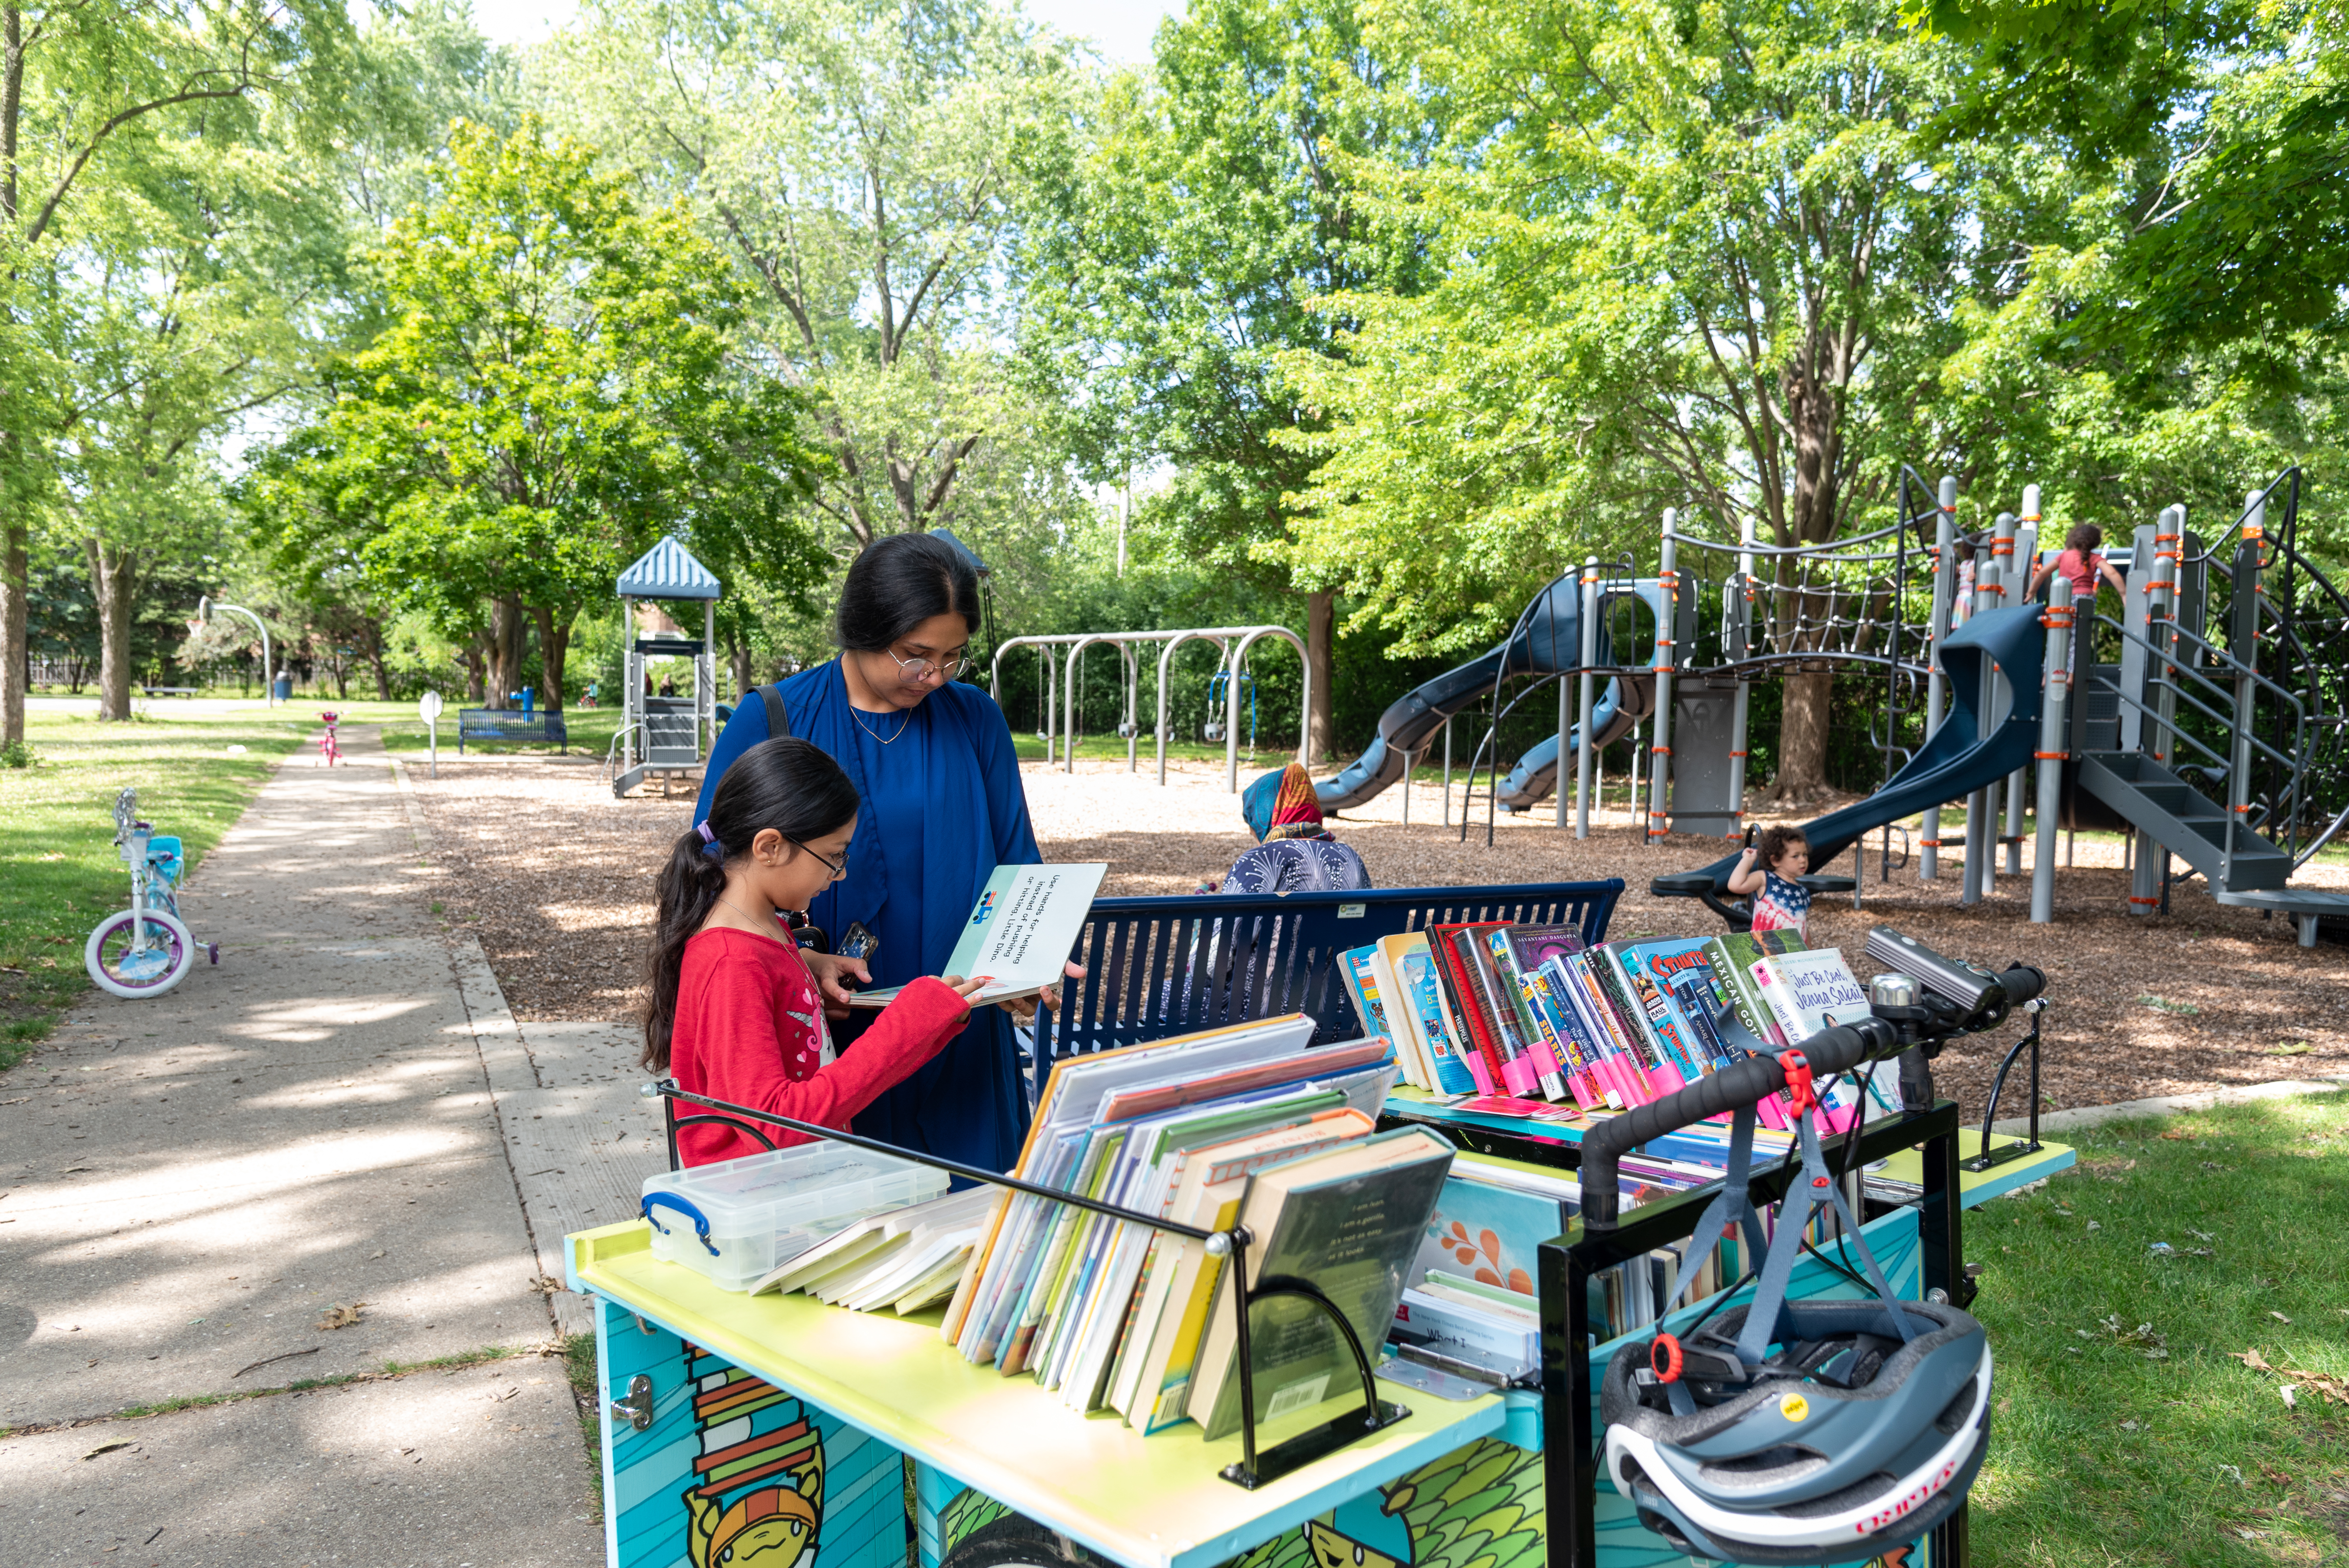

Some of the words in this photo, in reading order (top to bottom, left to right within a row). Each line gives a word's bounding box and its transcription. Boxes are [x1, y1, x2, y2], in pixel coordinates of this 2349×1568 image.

[1049, 875, 1060, 889] Use
[1010, 888, 1030, 916] hitting,
[1026, 881, 1045, 910] instead
[1036, 892, 1052, 915] hands
[1021, 913, 1028, 922] of
[1030, 919, 1039, 931] for
[1001, 919, 1015, 940] Little
[1004, 925, 1023, 957] pushing
[990, 943, 1004, 962] Dino.
[1013, 934, 1032, 964] helping
[1585, 952, 1595, 969] BEIL
[1430, 944, 1440, 963] MARJANE
[1437, 963, 1447, 980] SATRAPI
[1670, 972, 1690, 985] LUESTEM
[1793, 972, 1812, 988] Just
[1810, 971, 1825, 985] Be
[1824, 968, 1848, 984] Cool,
[1551, 987, 1561, 1001] STEAD
[1646, 995, 1660, 1006] JASON
[1710, 951, 1742, 1005] MEXICAN
[1741, 1010, 1761, 1039] GOTH
[1794, 990, 1833, 1010] Jenna
[1830, 983, 1863, 1005] Sakai
[1463, 955, 1486, 1001] CHARLIE
[1478, 1000, 1509, 1067] HERNÁNDEZ
[1506, 973, 1524, 1004] GAME
[1521, 1014, 1538, 1044] STARS
[1605, 996, 1615, 1010] THE
[1612, 1011, 1627, 1034] SECRET
[1651, 1007, 1666, 1017] RAÚL
[1774, 1001, 1789, 1020] Just
[1784, 1019, 1795, 1033] Be
[1455, 1015, 1468, 1043] PERSEPOLIS
[1604, 1013, 1618, 1033] MIGHTY
[1614, 1032, 1627, 1050] ROBOT
[1618, 1005, 1644, 1041] Maximillian
[1640, 1042, 1651, 1058] Fly
[1696, 1020, 1708, 1041] AMARI
[1539, 1019, 1566, 1066] SHARKS
[1576, 1039, 1585, 1050] Will
[1632, 1061, 1641, 1075] VOODOO
[1639, 1074, 1649, 1091] VULTURES
[1827, 1098, 1837, 1107] High
[1343, 1234, 1356, 1242] not
[1367, 1228, 1383, 1237] easy
[1454, 1323, 1480, 1337] Best-Selling
[1481, 1331, 1495, 1340] Series
[1642, 1494, 1658, 1508] ISODE
[1856, 1485, 1929, 1534] GIRO
